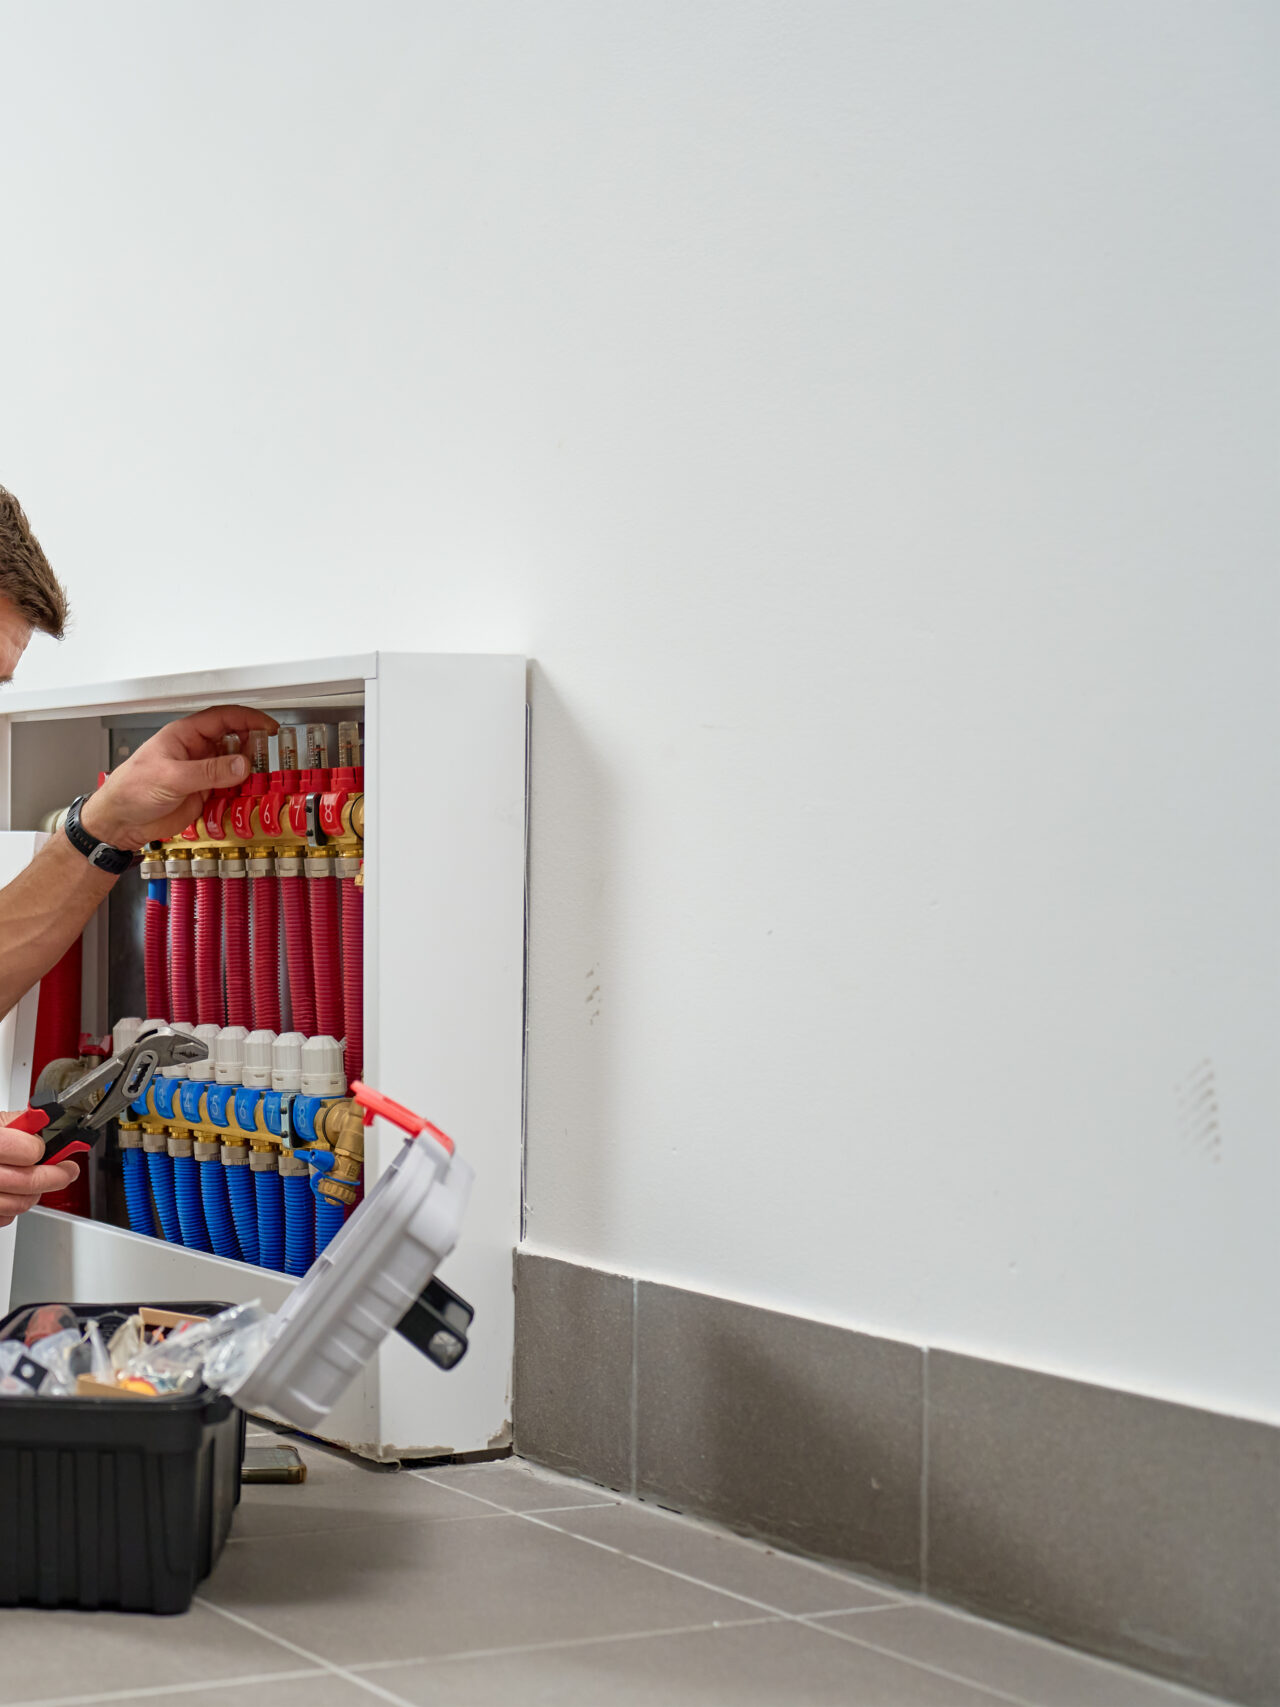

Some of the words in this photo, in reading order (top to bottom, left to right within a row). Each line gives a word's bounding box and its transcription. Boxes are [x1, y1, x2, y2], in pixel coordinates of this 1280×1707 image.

[235, 806, 243, 828] 5
[263, 803, 271, 825] 6
[294, 805, 301, 827] 7
[324, 803, 333, 823] 8
[184, 1092, 191, 1113] 4
[210, 1094, 219, 1116] 5
[239, 1098, 246, 1120] 6
[268, 1104, 275, 1126] 7
[298, 1105, 306, 1129] 8
